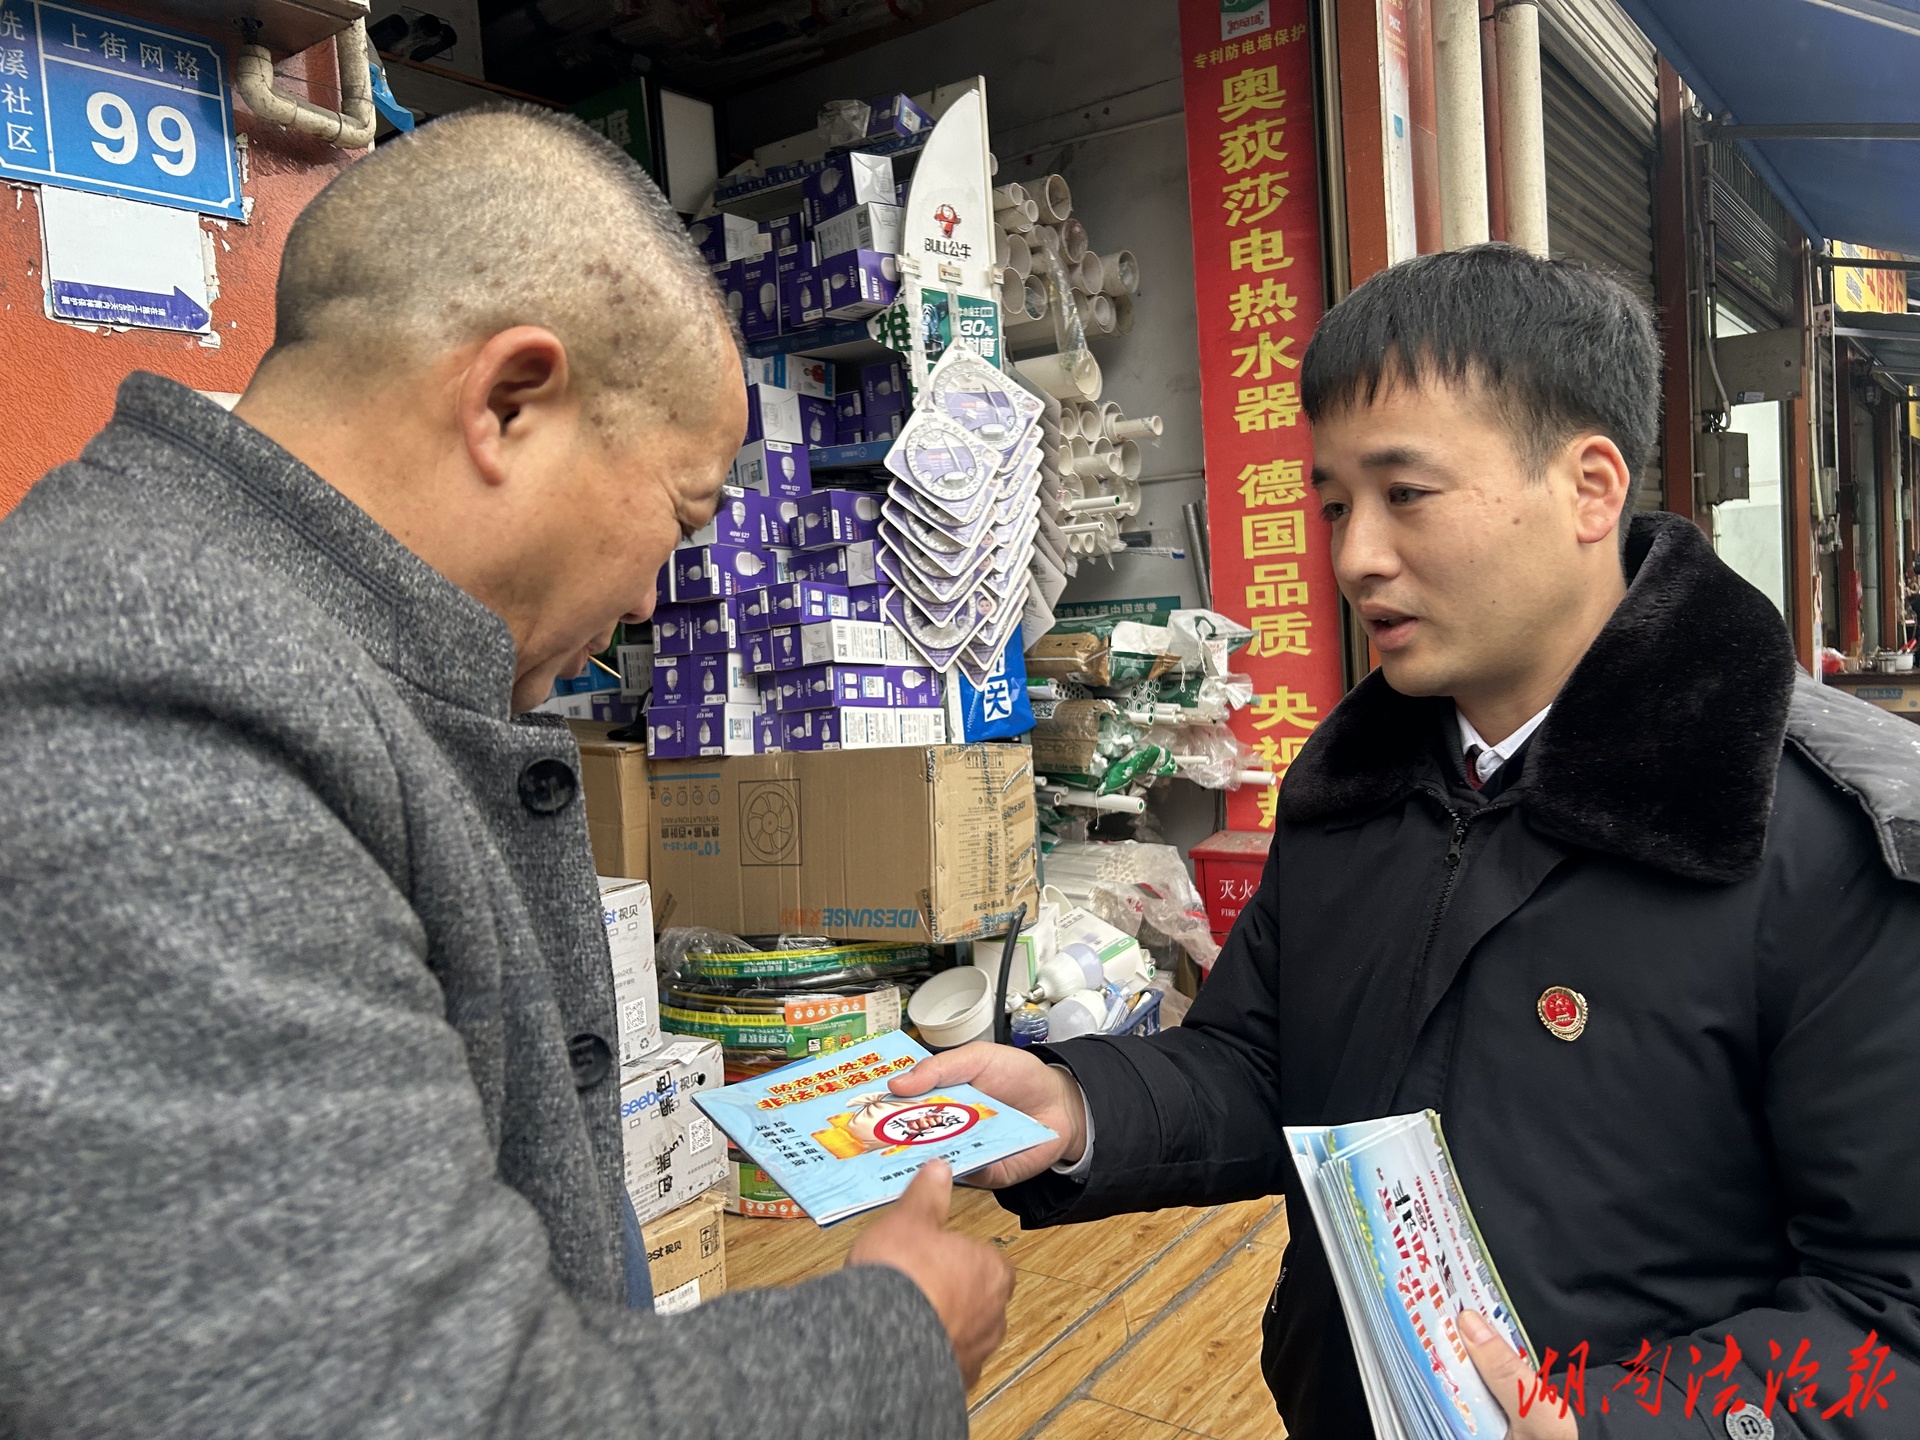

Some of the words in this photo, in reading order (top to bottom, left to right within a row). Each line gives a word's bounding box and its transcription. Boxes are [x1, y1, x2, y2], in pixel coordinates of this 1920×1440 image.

[62, 23, 201, 82] 上街网格
[1193, 24, 1306, 69] 专利防电墙保护
[85, 91, 197, 178] 99
[1217, 65, 1302, 433] 奥荻莎电热水器
[961, 319, 994, 337] 30%
[1236, 459, 1313, 659] 德国品质
[1219, 879, 1262, 901] 灭火
[822, 908, 919, 929] IDESUNSE
[756, 1055, 916, 1110] 非法集资条例
[766, 1051, 884, 1095] 防范和处置
